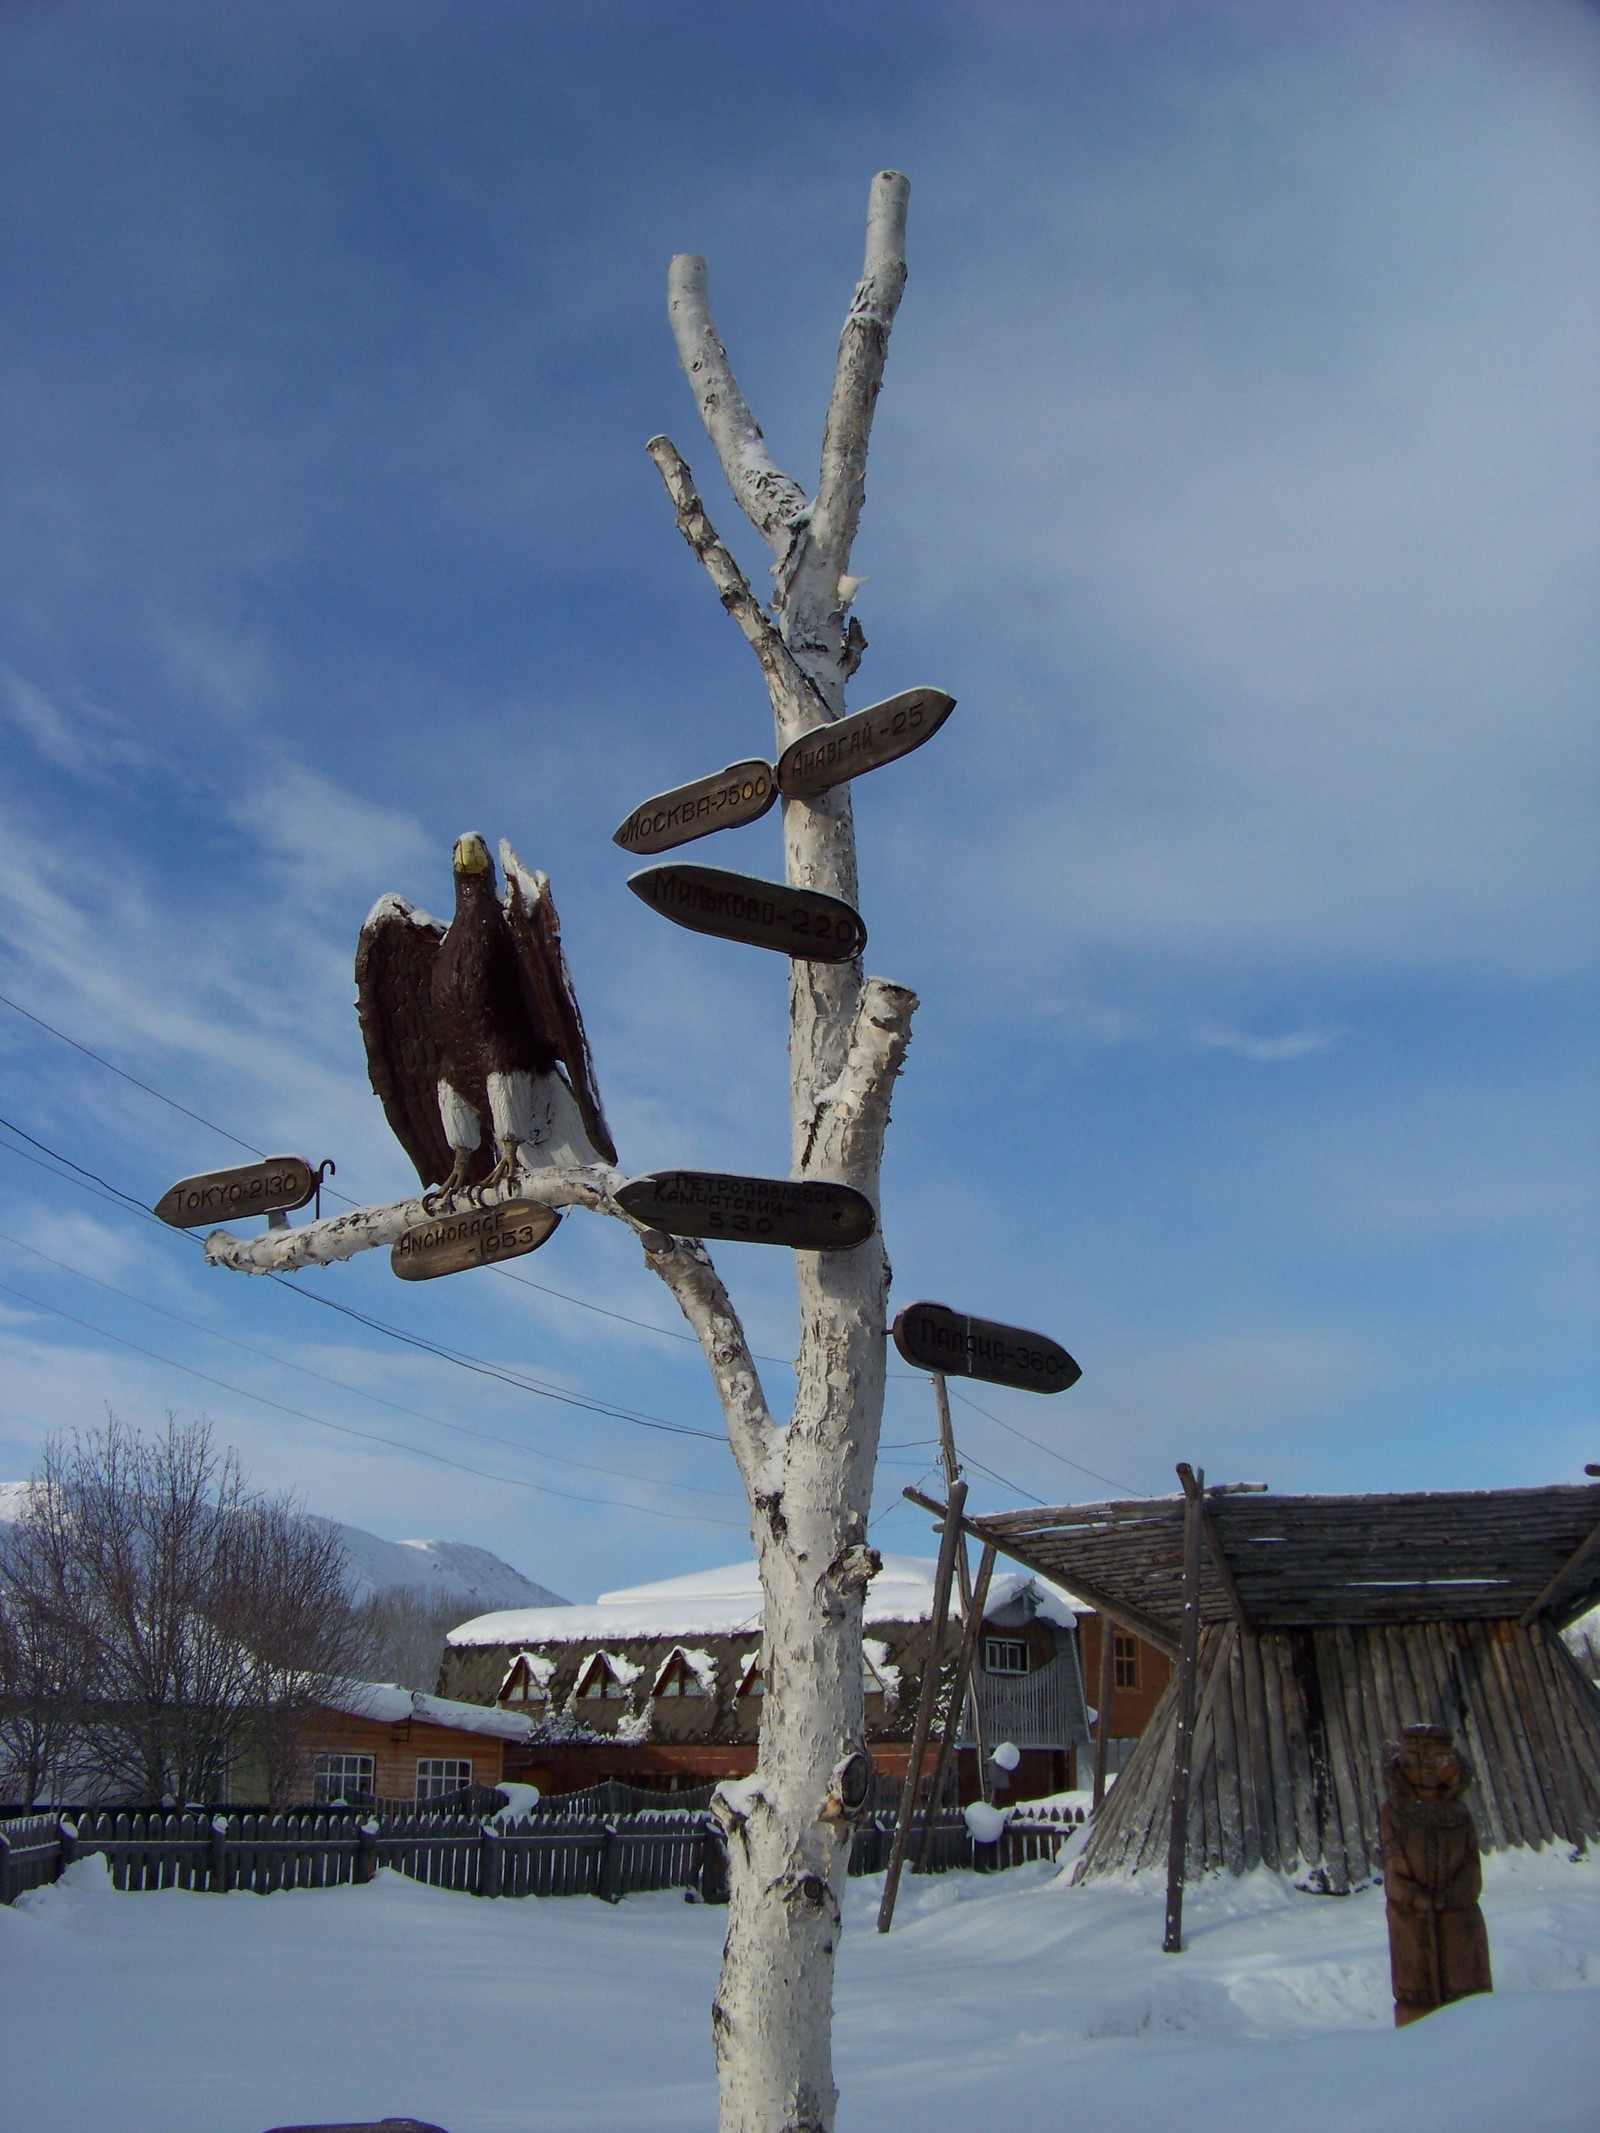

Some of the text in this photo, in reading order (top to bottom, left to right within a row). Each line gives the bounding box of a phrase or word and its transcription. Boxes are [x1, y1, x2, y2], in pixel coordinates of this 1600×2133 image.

[174, 1174, 298, 1213] TOKYO-2130
[400, 1212, 505, 1256] ANCHORAGE
[708, 1211, 774, 1234] 530
[467, 1225, 534, 1256] -1953
